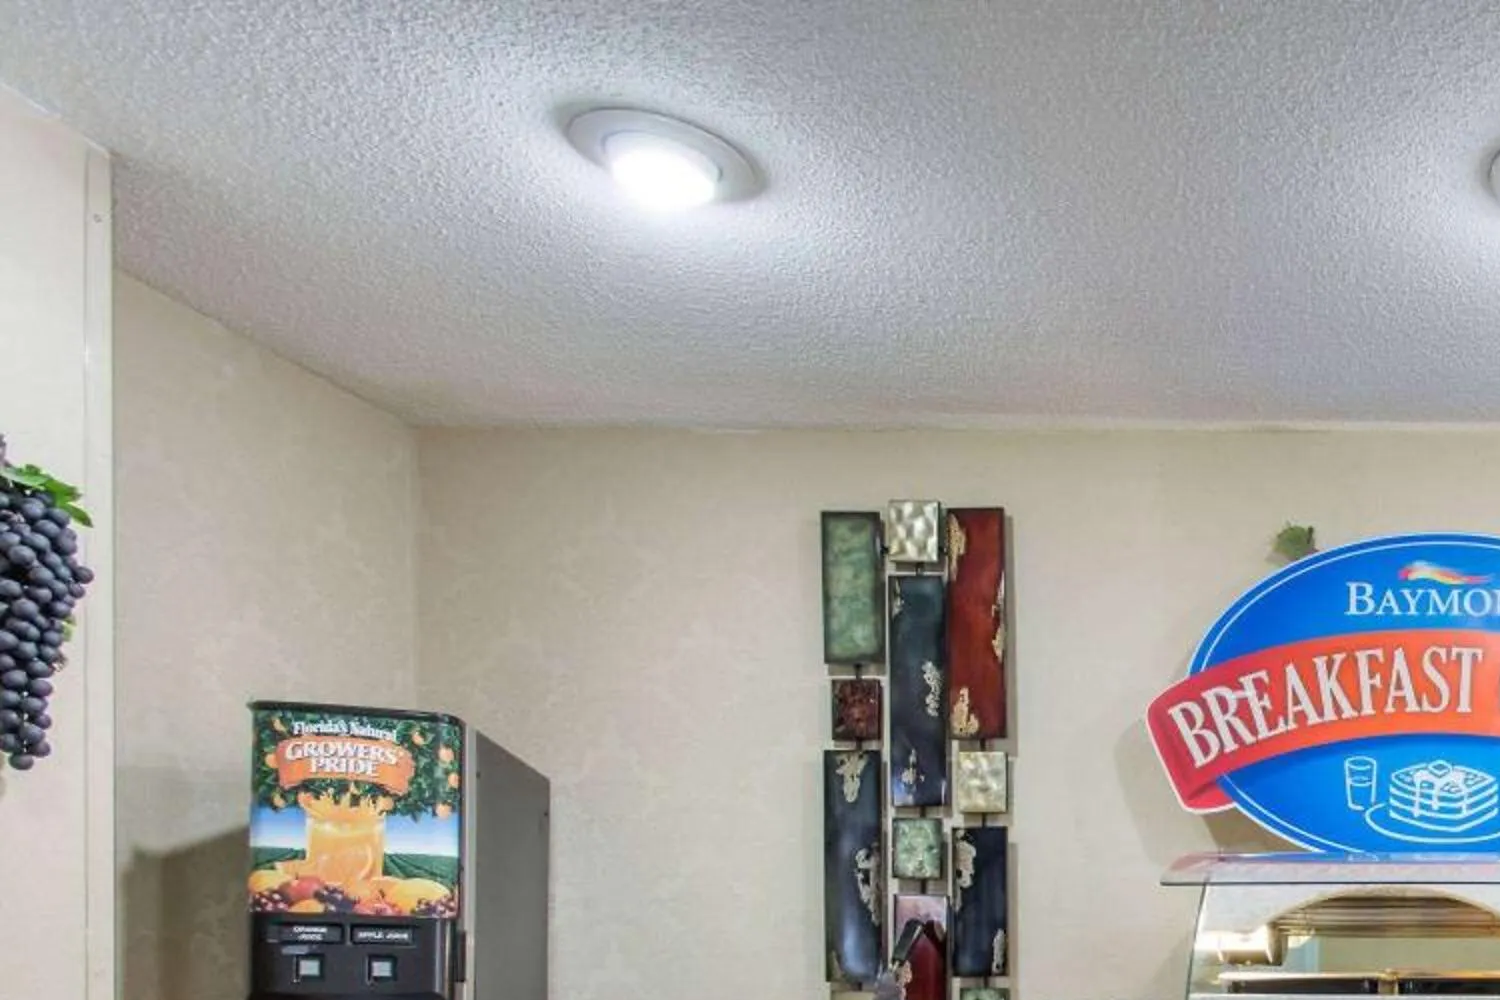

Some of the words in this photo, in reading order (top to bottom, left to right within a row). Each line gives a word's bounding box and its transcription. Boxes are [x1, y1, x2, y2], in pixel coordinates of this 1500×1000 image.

[1168, 646, 1484, 768] BREAKFAST
[291, 719, 348, 736] Florida's
[348, 721, 398, 742] Natural
[309, 758, 378, 777] PRIDE
